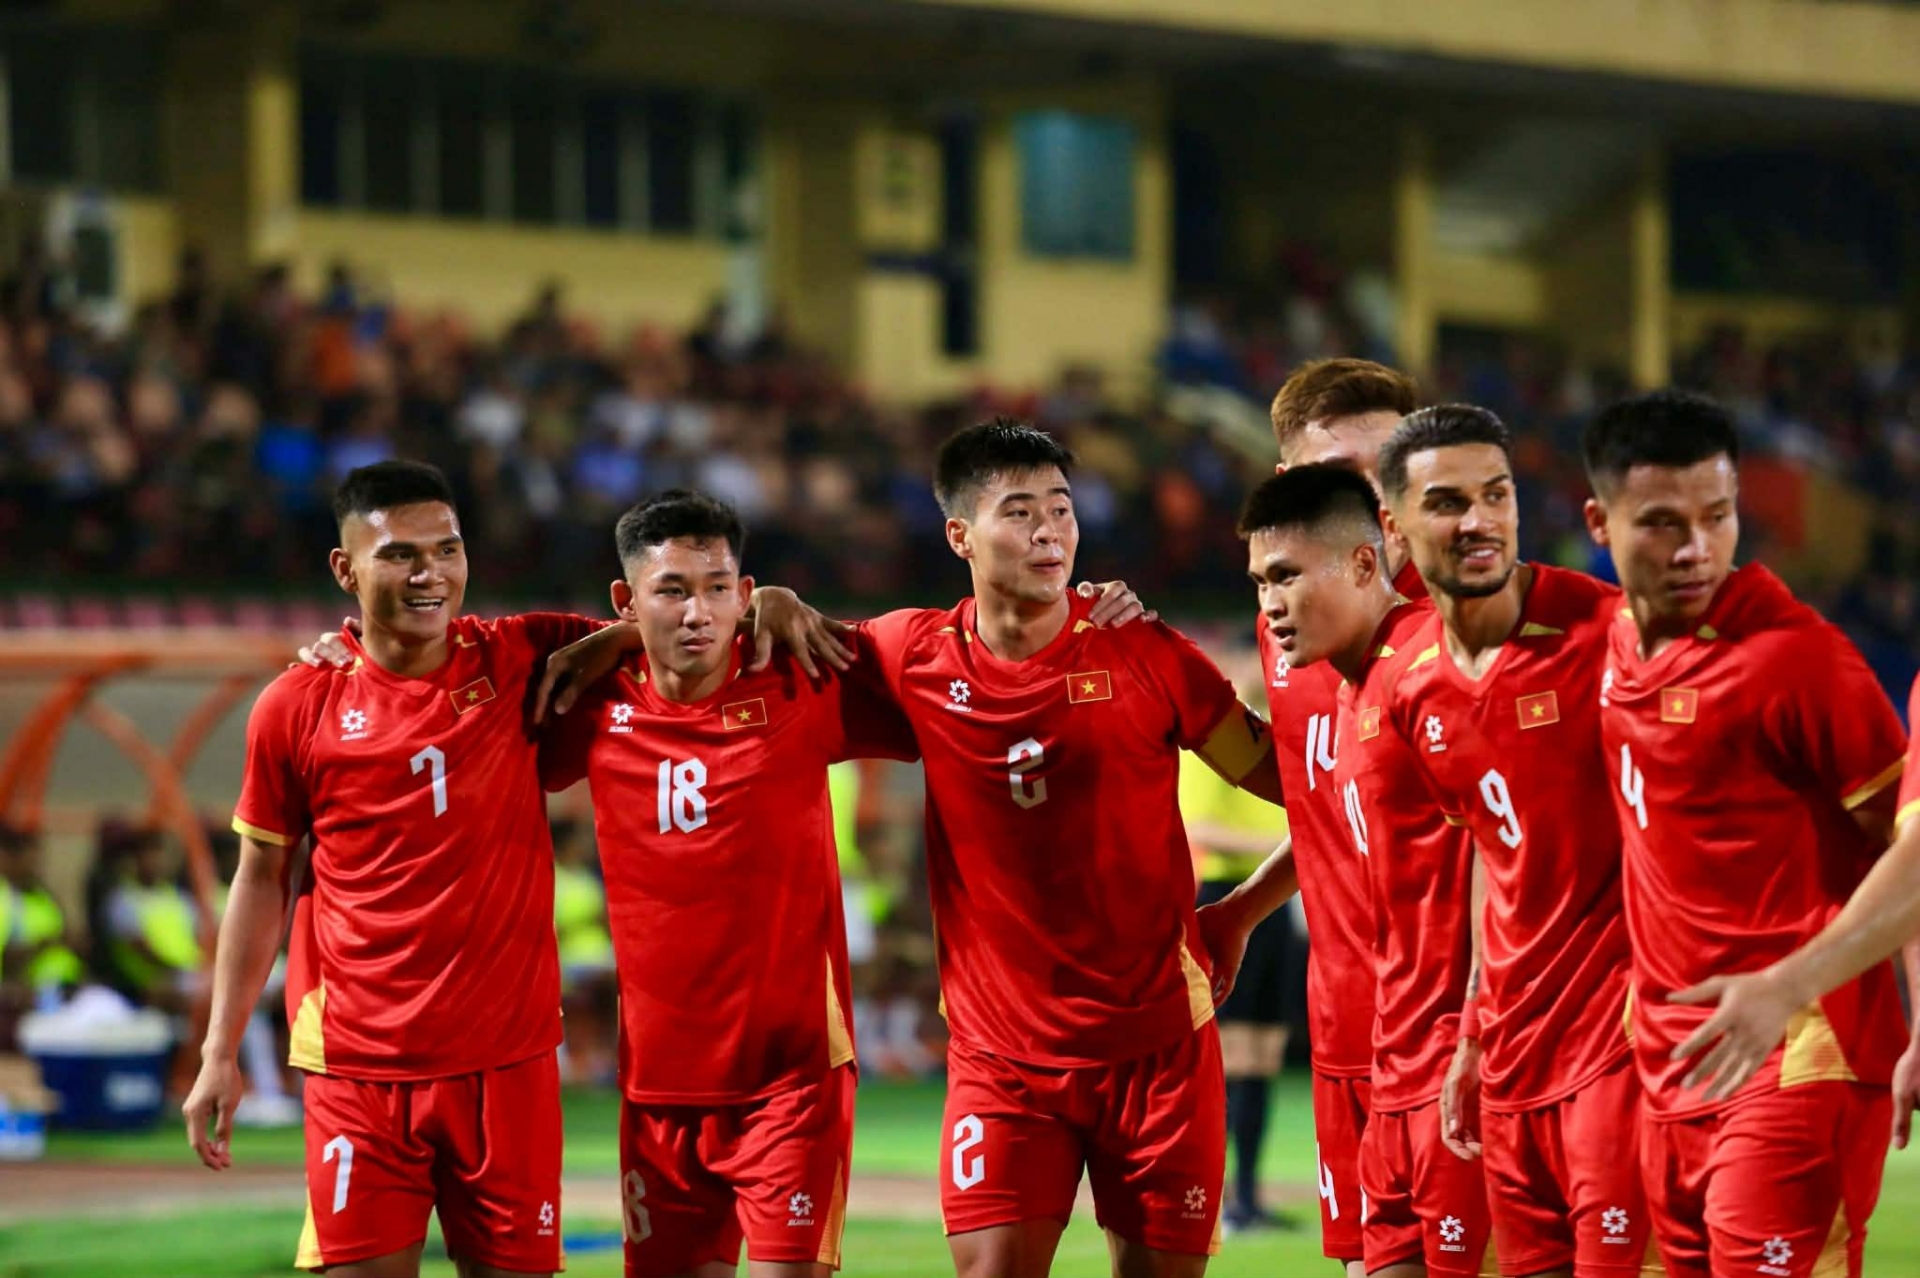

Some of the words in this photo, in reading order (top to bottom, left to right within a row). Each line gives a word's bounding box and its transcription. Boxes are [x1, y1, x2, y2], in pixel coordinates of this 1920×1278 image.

[410, 744, 447, 818] 7
[658, 757, 708, 835] 18
[1007, 736, 1048, 810] 2
[1478, 767, 1523, 849] 9
[1621, 742, 1649, 831] 4
[323, 1134, 353, 1215] 7
[953, 1113, 985, 1191] 2
